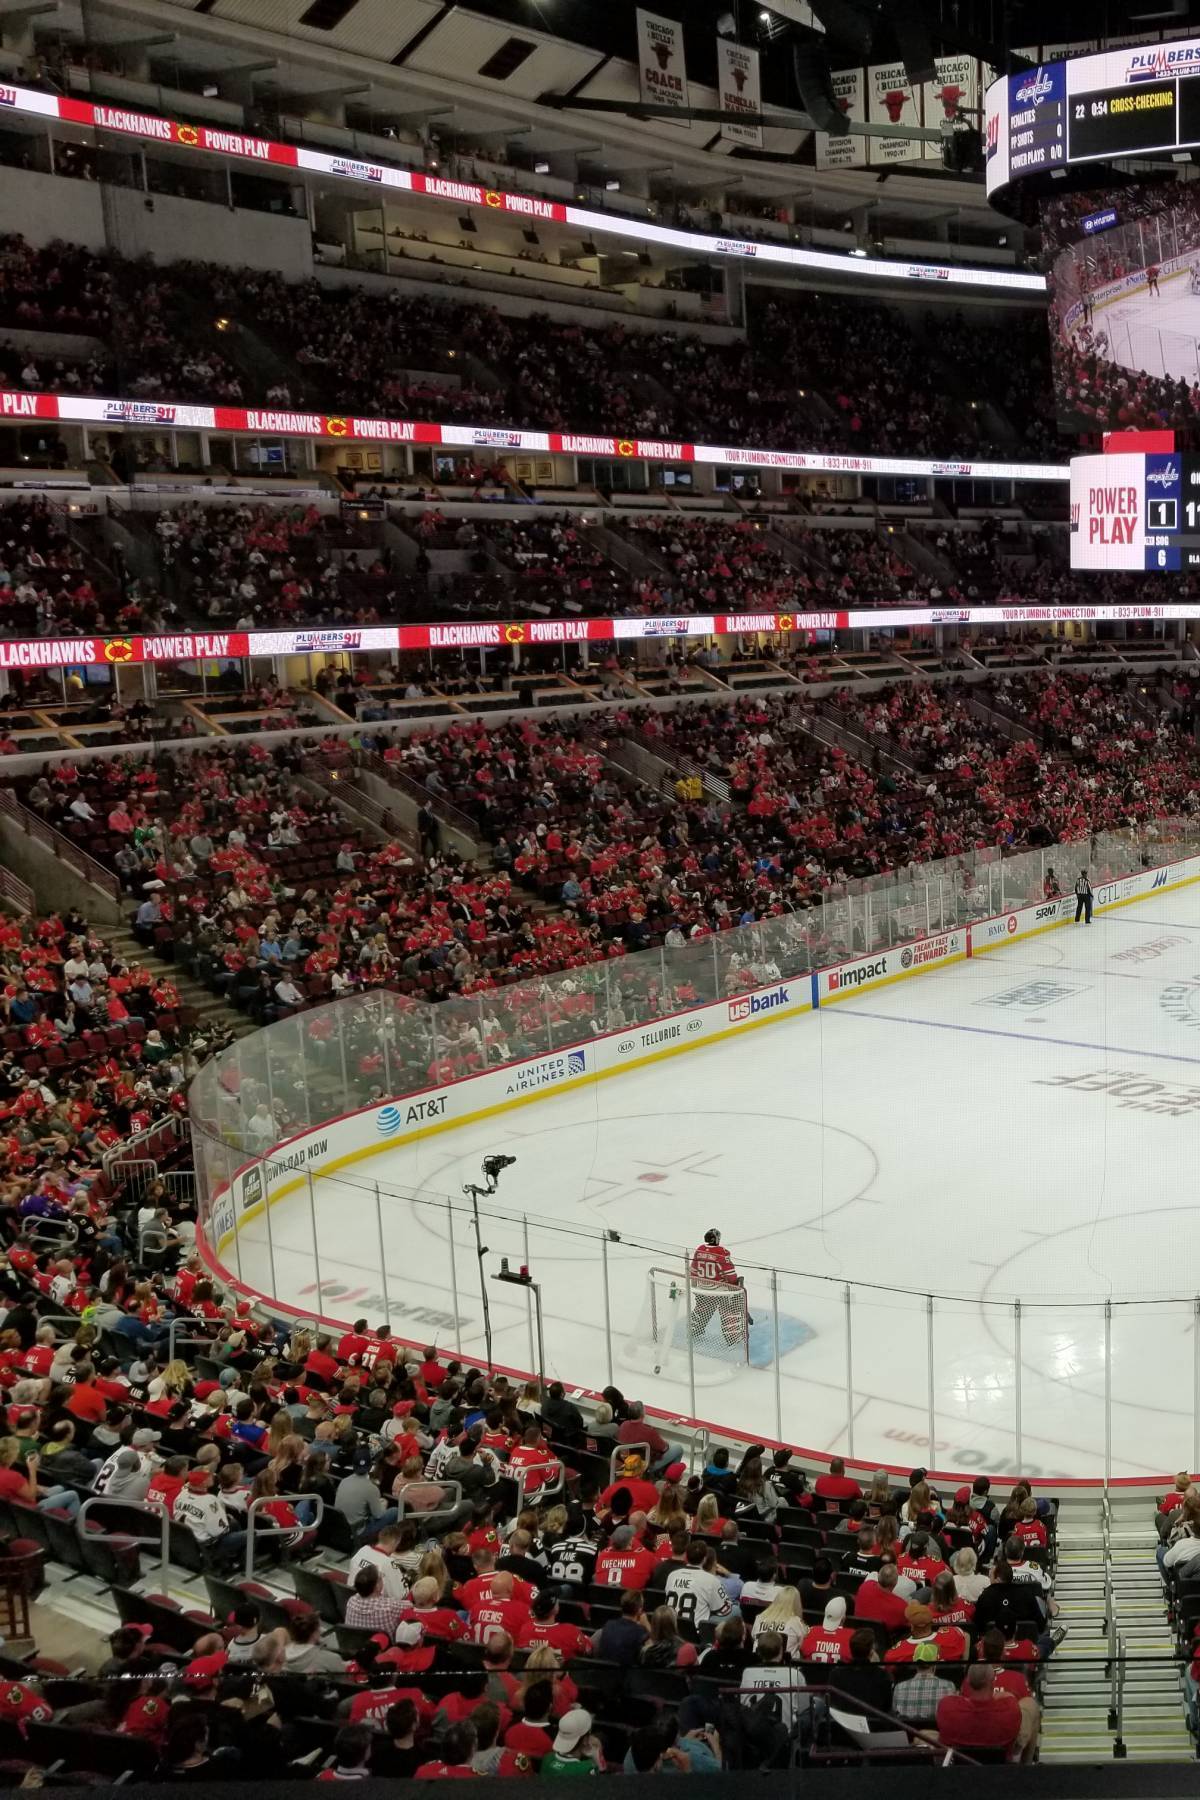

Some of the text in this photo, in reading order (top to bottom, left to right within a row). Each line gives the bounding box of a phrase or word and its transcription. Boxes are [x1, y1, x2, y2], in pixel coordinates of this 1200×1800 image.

[646, 20, 675, 37] CHICAGO
[645, 68, 682, 92] COACH
[1075, 91, 1173, 119] 22 0:54 CROSS-CHECKING
[1010, 108, 1036, 130] PENALTIES
[92, 106, 270, 159] BLACKHAWKS POWER PLAY
[1010, 123, 1062, 150] PP SHOTS 0
[1011, 146, 1062, 170] POWER PLAYS 0/0
[425, 177, 554, 218] BLACKHAWKS POWER PLAY
[2, 394, 37, 415] PLAY
[247, 411, 415, 440] BLACKHAWKS POWER PLAY
[561, 436, 682, 458] BLACKHAWKS POWER PLAY
[724, 450, 806, 467] YOUR PLUMBING CONNECTION
[1089, 487, 1137, 515] POWER
[1158, 503, 1167, 525] 1
[1089, 517, 1138, 544] PLAY
[1155, 536, 1169, 546] SOG
[1158, 551, 1166, 567] 6
[726, 612, 837, 631] BLACKHAWKS POWER PLAY
[1002, 606, 1096, 620] YOUR PLUMBING CONNECTION
[429, 621, 589, 646] BLACKHAWKS POWER PLAY
[143, 635, 230, 660] POWER PLAY
[1098, 883, 1121, 905] GTL
[1036, 904, 1057, 920] SRM
[988, 925, 1006, 937] BMO
[913, 946, 948, 965] REWARDS
[914, 936, 949, 956] FREAKY FAST
[839, 957, 888, 988] impact
[641, 1025, 681, 1047] TELLURIDE
[517, 1058, 564, 1080] UNITED
[506, 1068, 565, 1095] AIRLINES
[405, 1096, 448, 1125] AT&T
[307, 1139, 328, 1160] NOW
[697, 1261, 717, 1279] 50
[354, 1297, 474, 1330] BELFOR
[559, 1552, 577, 1562] KANE
[601, 1558, 636, 1569] OVECHKIN
[674, 1578, 692, 1589] KANE
[902, 1567, 927, 1580] STROME
[478, 1611, 504, 1624] TOEWS
[758, 1621, 786, 1633] TOEWS
[816, 1642, 840, 1654] TOVAR
